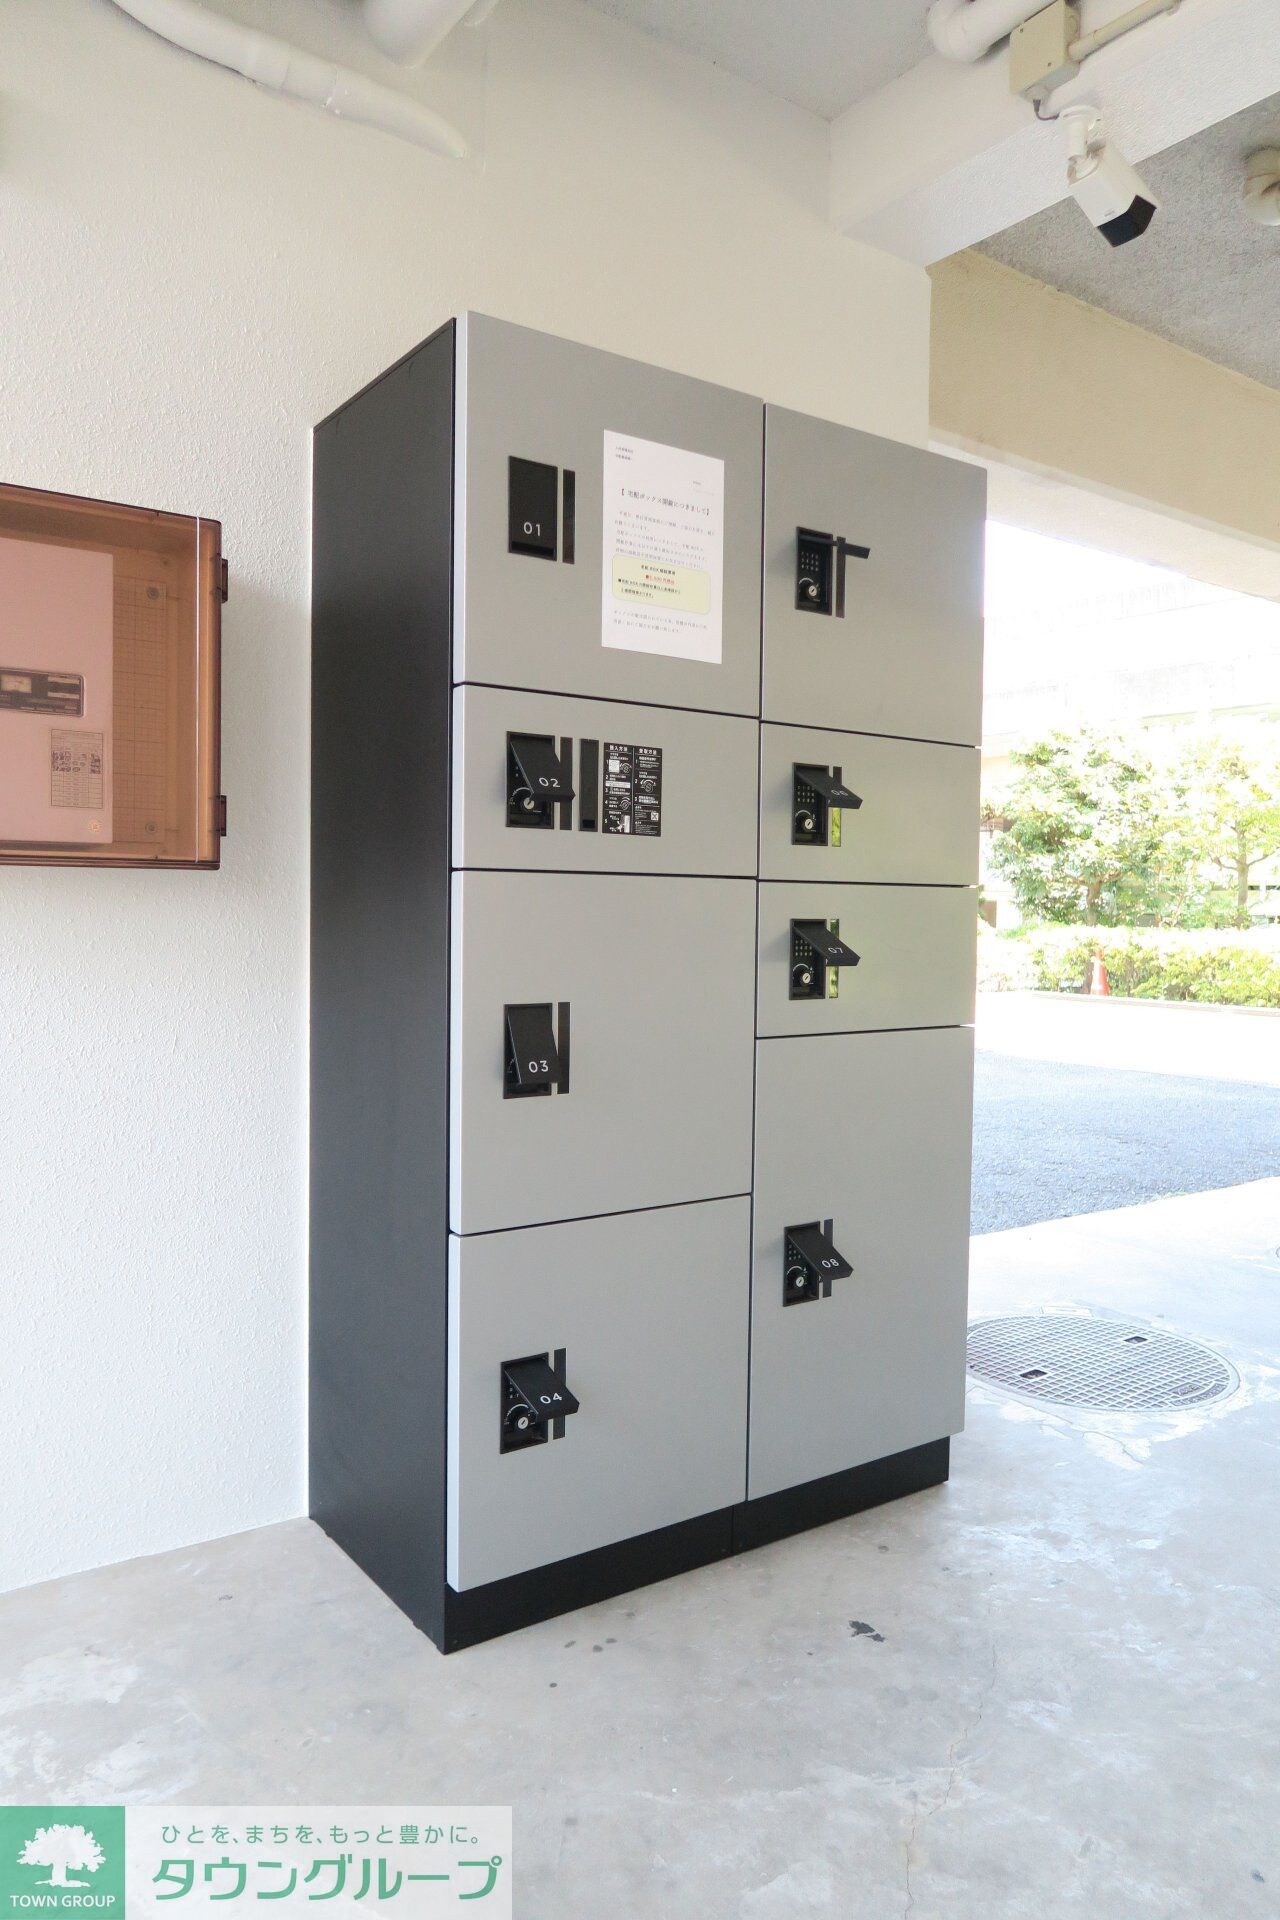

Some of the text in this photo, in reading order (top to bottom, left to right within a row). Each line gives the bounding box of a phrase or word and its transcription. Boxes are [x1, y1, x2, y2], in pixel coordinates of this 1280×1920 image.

[523, 521, 541, 537] 01
[538, 777, 561, 788] 02
[528, 1060, 549, 1073] 03
[821, 1258, 839, 1268] 08
[540, 1392, 563, 1404] 04
